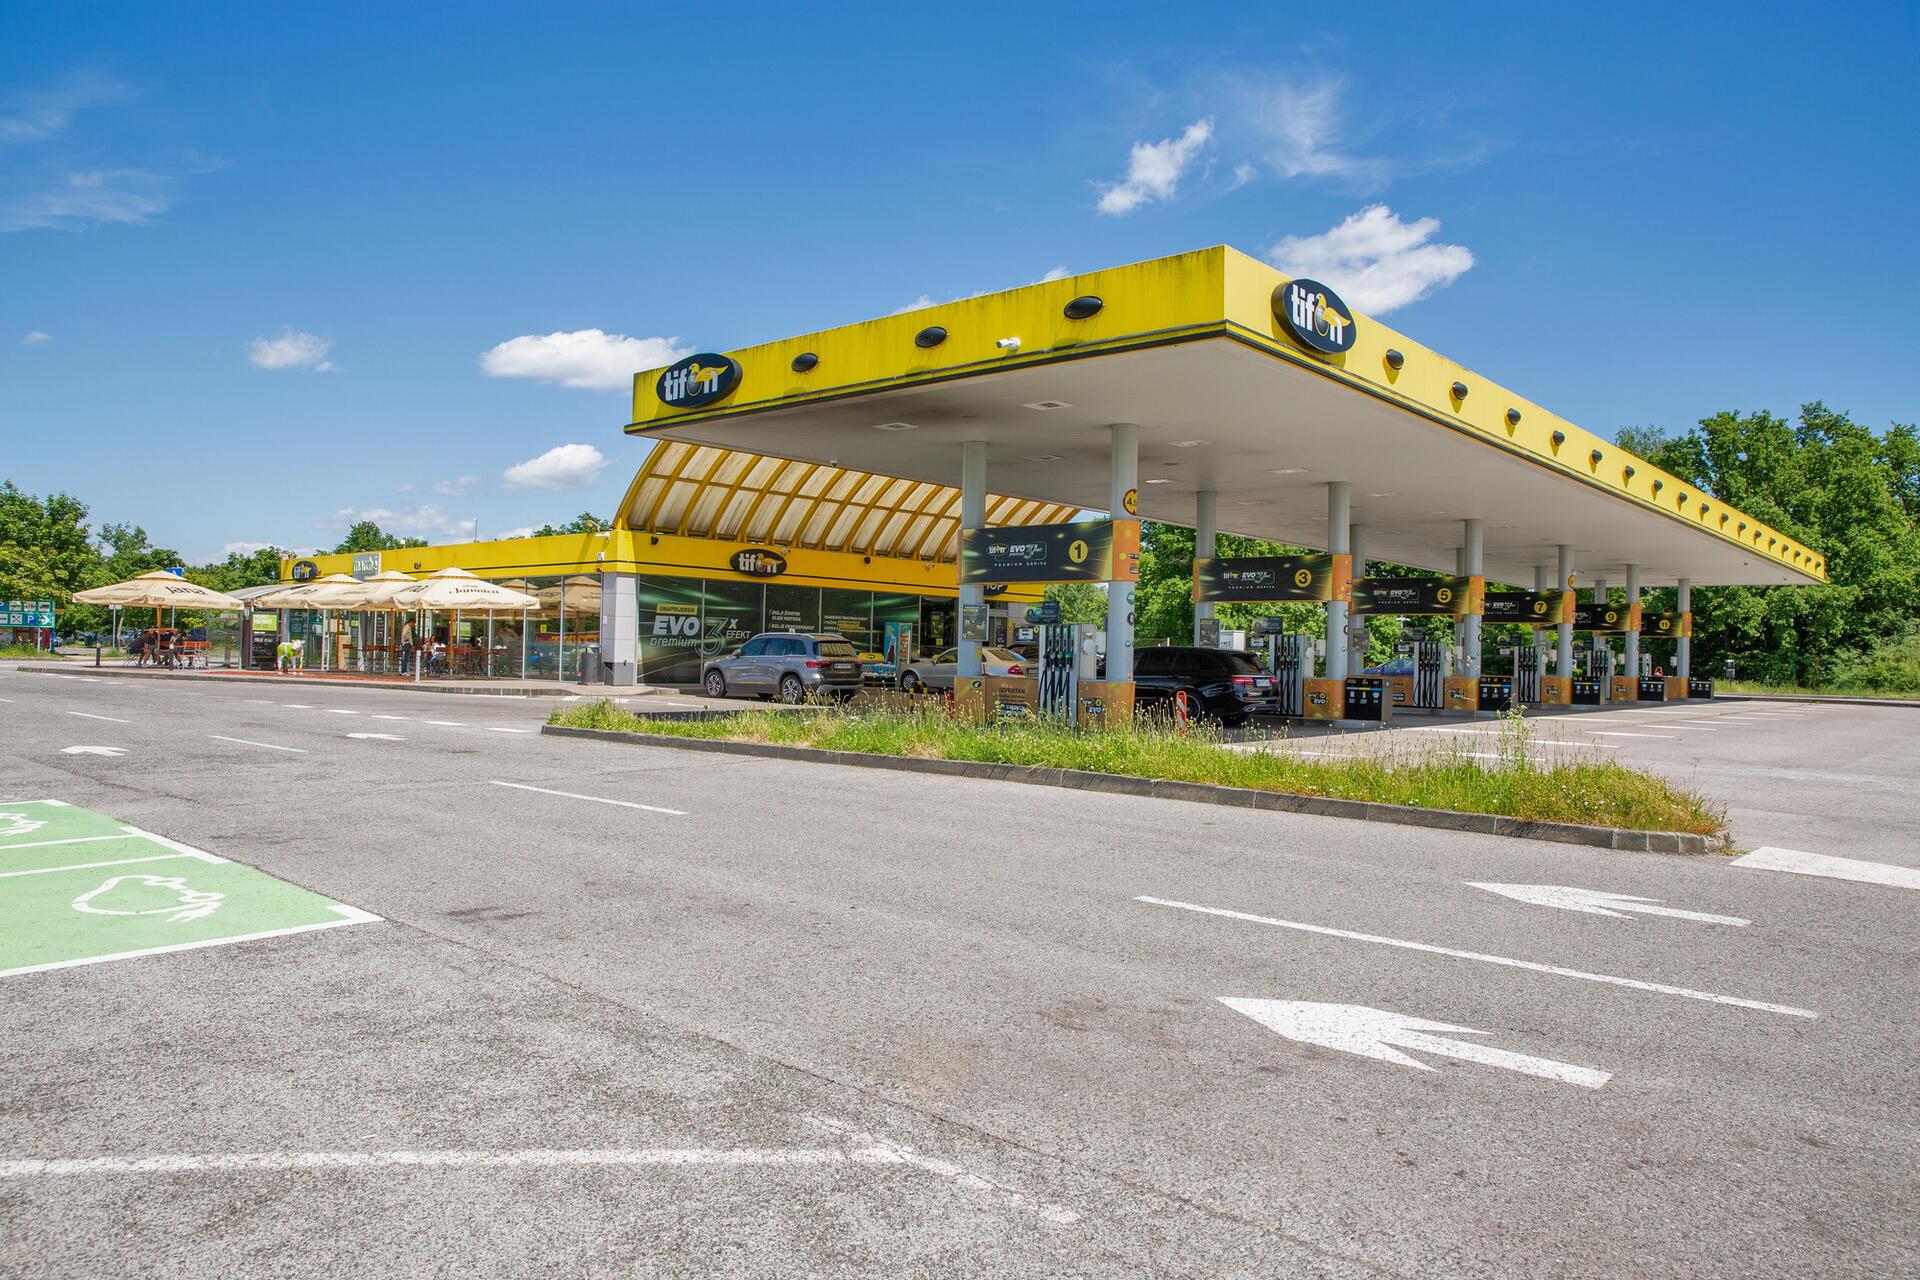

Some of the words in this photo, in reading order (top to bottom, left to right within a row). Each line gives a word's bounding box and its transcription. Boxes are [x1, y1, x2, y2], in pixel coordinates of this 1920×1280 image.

[1291, 283, 1351, 345] tifon
[664, 363, 728, 401] tifon
[1009, 545, 1025, 553] EVO
[1075, 543, 1082, 559] 1
[739, 552, 783, 573] tifon
[1298, 572, 1308, 585] 3
[1440, 590, 1449, 601] 5
[1536, 602, 1543, 612] 7
[27, 615, 35, 624] P
[652, 615, 700, 637] EVO
[726, 630, 751, 639] EFEKT
[649, 636, 697, 648] premium
